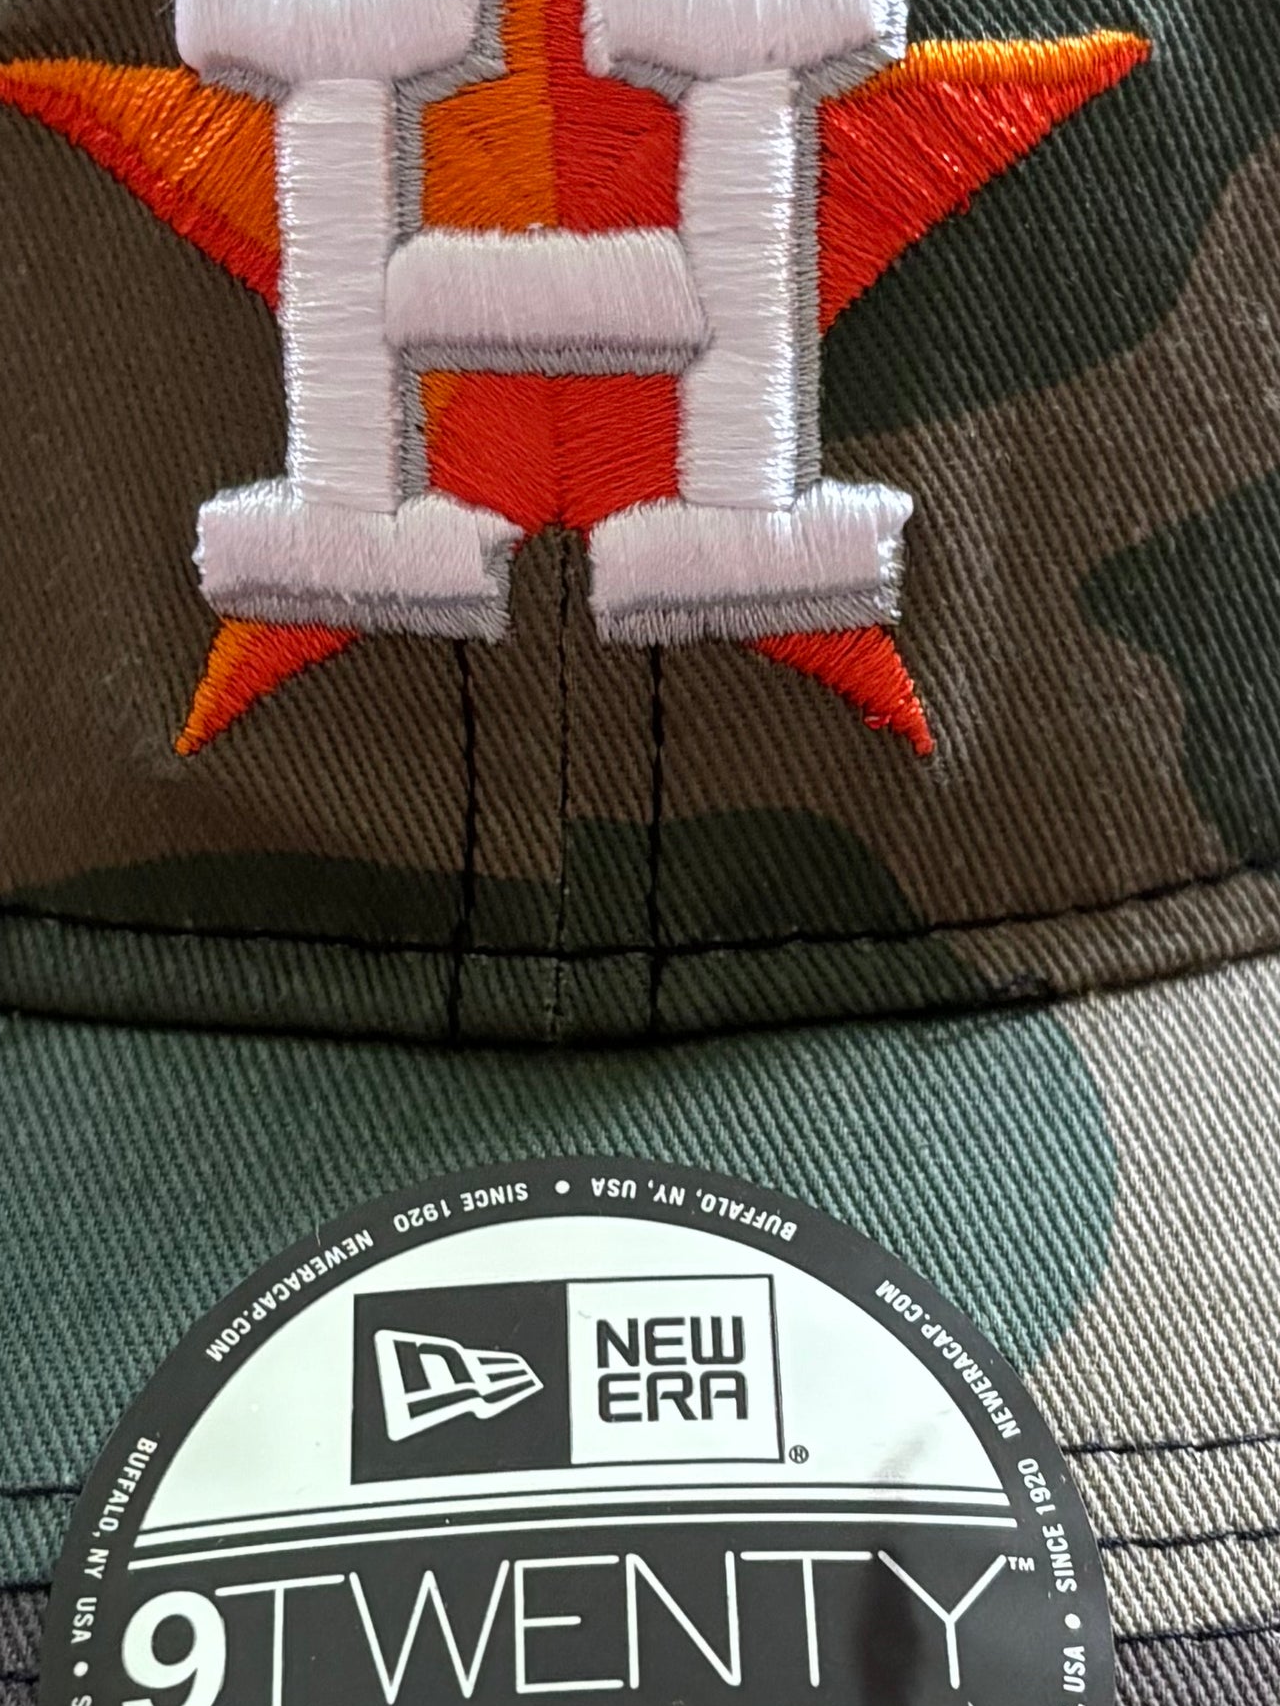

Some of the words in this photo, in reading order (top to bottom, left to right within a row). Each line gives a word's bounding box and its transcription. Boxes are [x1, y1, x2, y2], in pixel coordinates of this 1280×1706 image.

[460, 1182, 529, 1212] SINCE
[590, 1177, 637, 1199] USA
[647, 1178, 686, 1206] NY,
[695, 1187, 798, 1242] BUFFALO,
[393, 1199, 451, 1233] 1920
[205, 1229, 374, 1363] NEWERACAP.COM
[596, 1315, 746, 1368] NEW
[875, 1280, 1021, 1439] NEWERACAP.COM
[597, 1370, 749, 1423] ERA
[91, 1437, 158, 1538] BUFFALO,
[1017, 1458, 1056, 1516] 1920
[1042, 1523, 1078, 1593] SINCE
[70, 1596, 98, 1644] USA
[1063, 1646, 1087, 1693] USA
